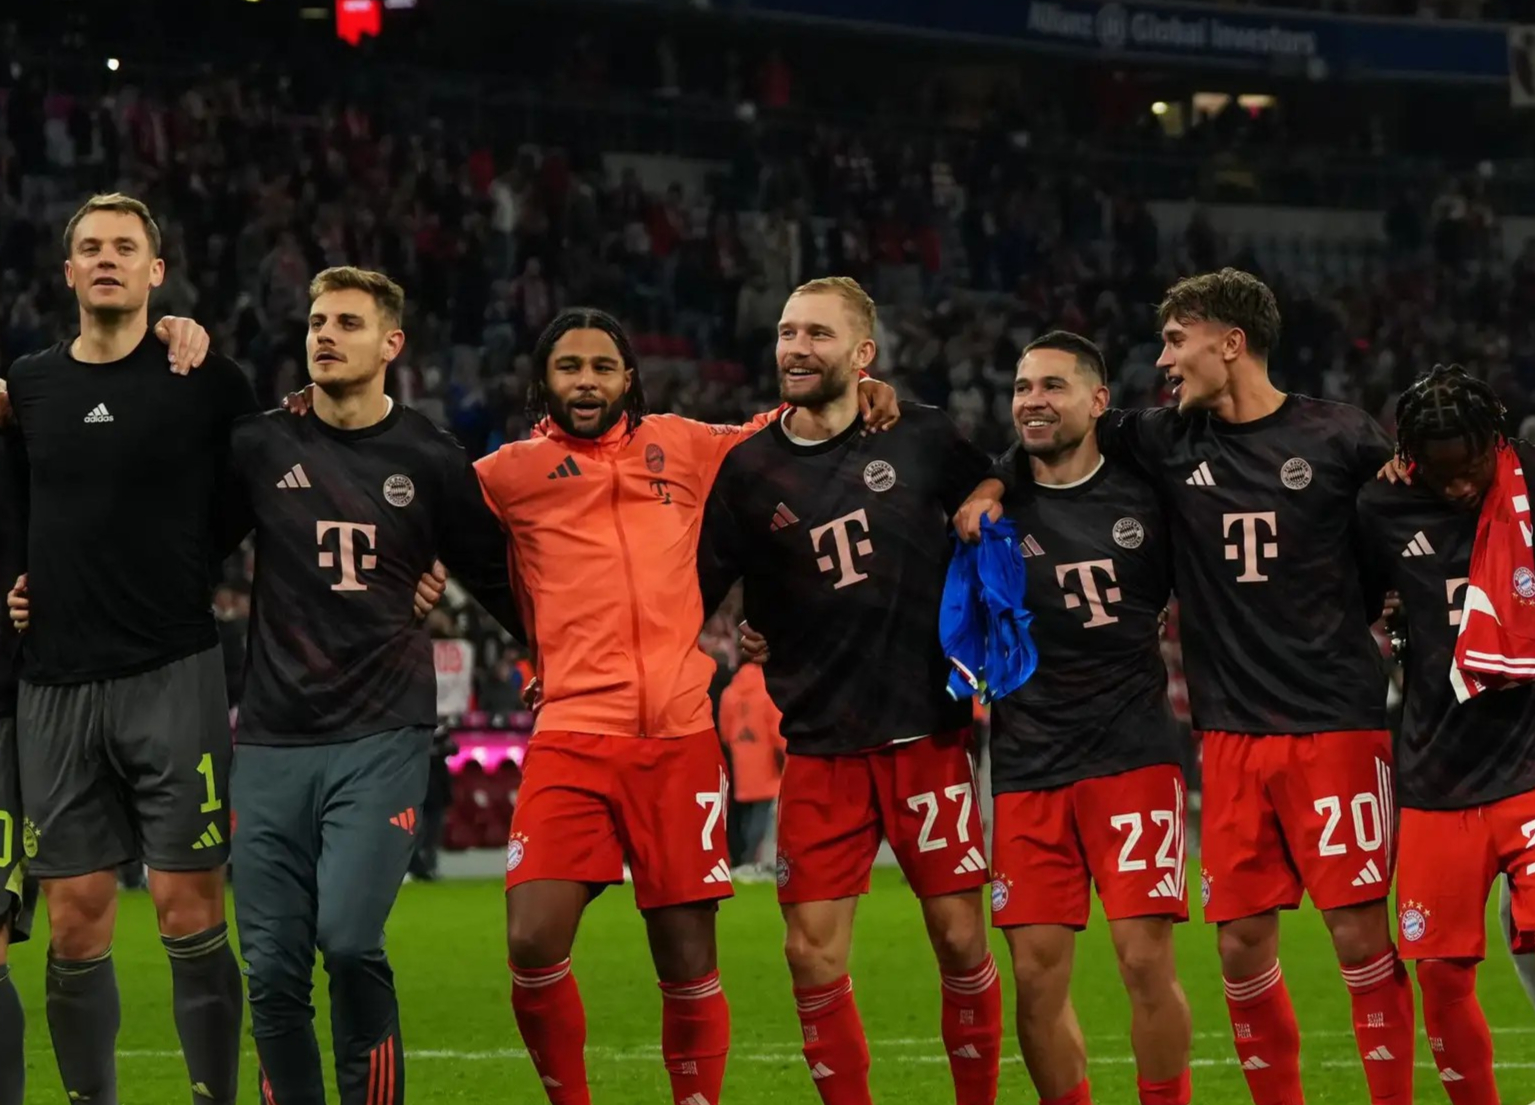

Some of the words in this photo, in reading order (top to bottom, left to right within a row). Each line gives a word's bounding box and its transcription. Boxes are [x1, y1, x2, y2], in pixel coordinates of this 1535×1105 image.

[84, 415, 114, 423] adidas
[317, 521, 376, 590] T
[810, 508, 873, 589] T
[1223, 511, 1277, 582] T
[1056, 558, 1121, 628] T
[197, 753, 221, 813] 1
[696, 792, 724, 850] 7
[908, 783, 973, 852] 27
[1111, 810, 1176, 872] 22
[1314, 792, 1383, 857] 20
